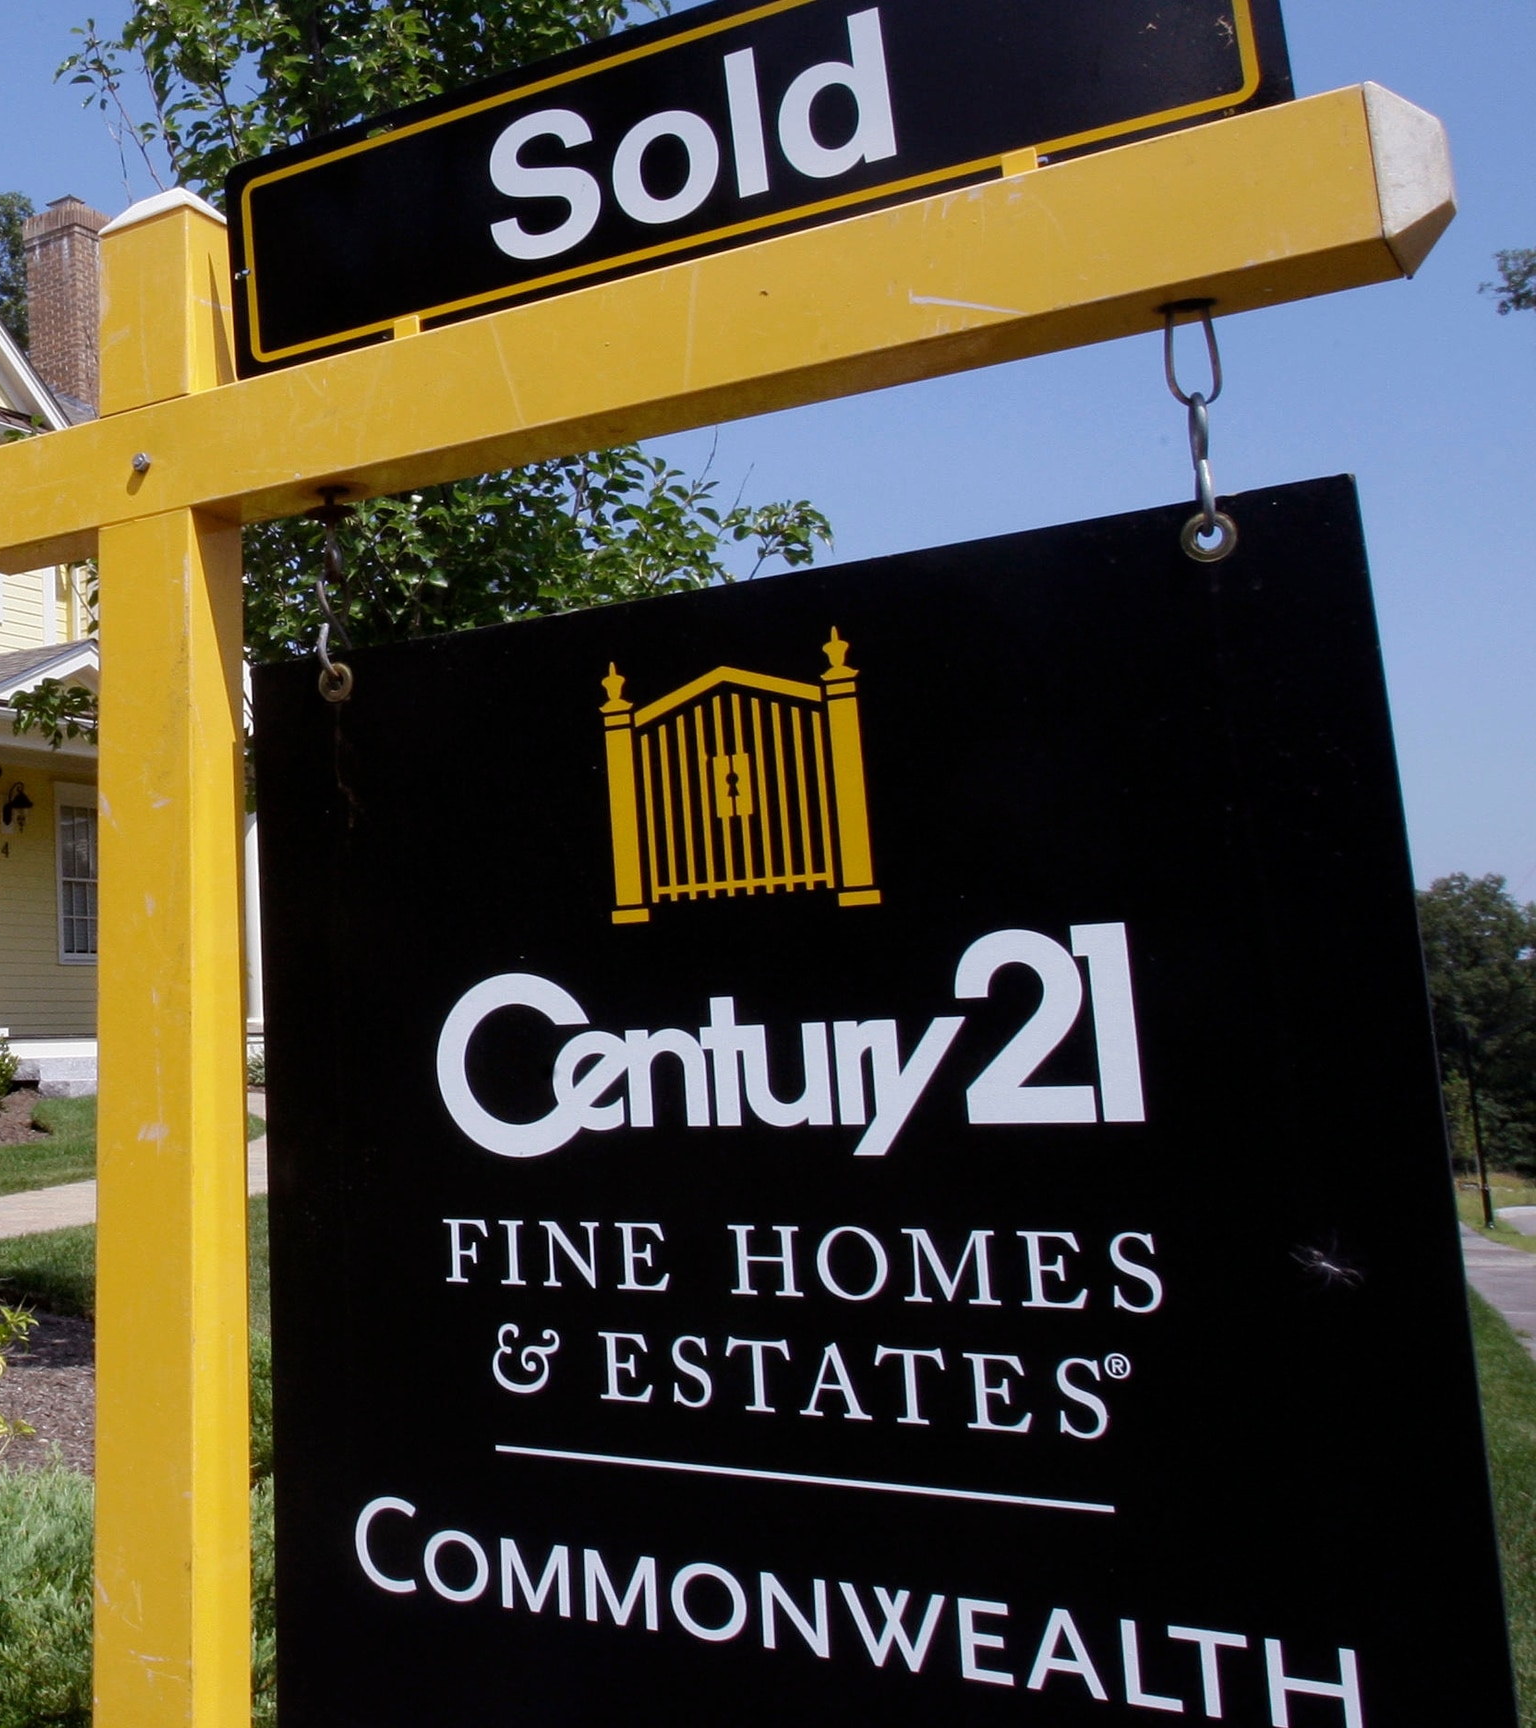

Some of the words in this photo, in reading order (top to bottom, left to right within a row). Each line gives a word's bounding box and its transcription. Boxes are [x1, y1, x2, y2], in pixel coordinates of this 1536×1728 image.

[490, 7, 898, 260] Sold
[1, 841, 9, 858] 4
[437, 972, 965, 1158] Century
[954, 921, 1146, 1125] 21
[442, 1218, 670, 1292] FINE
[727, 1224, 1163, 1313] HOMES
[492, 1323, 560, 1394] &
[355, 1496, 1363, 1728] COMMONWEALTH
